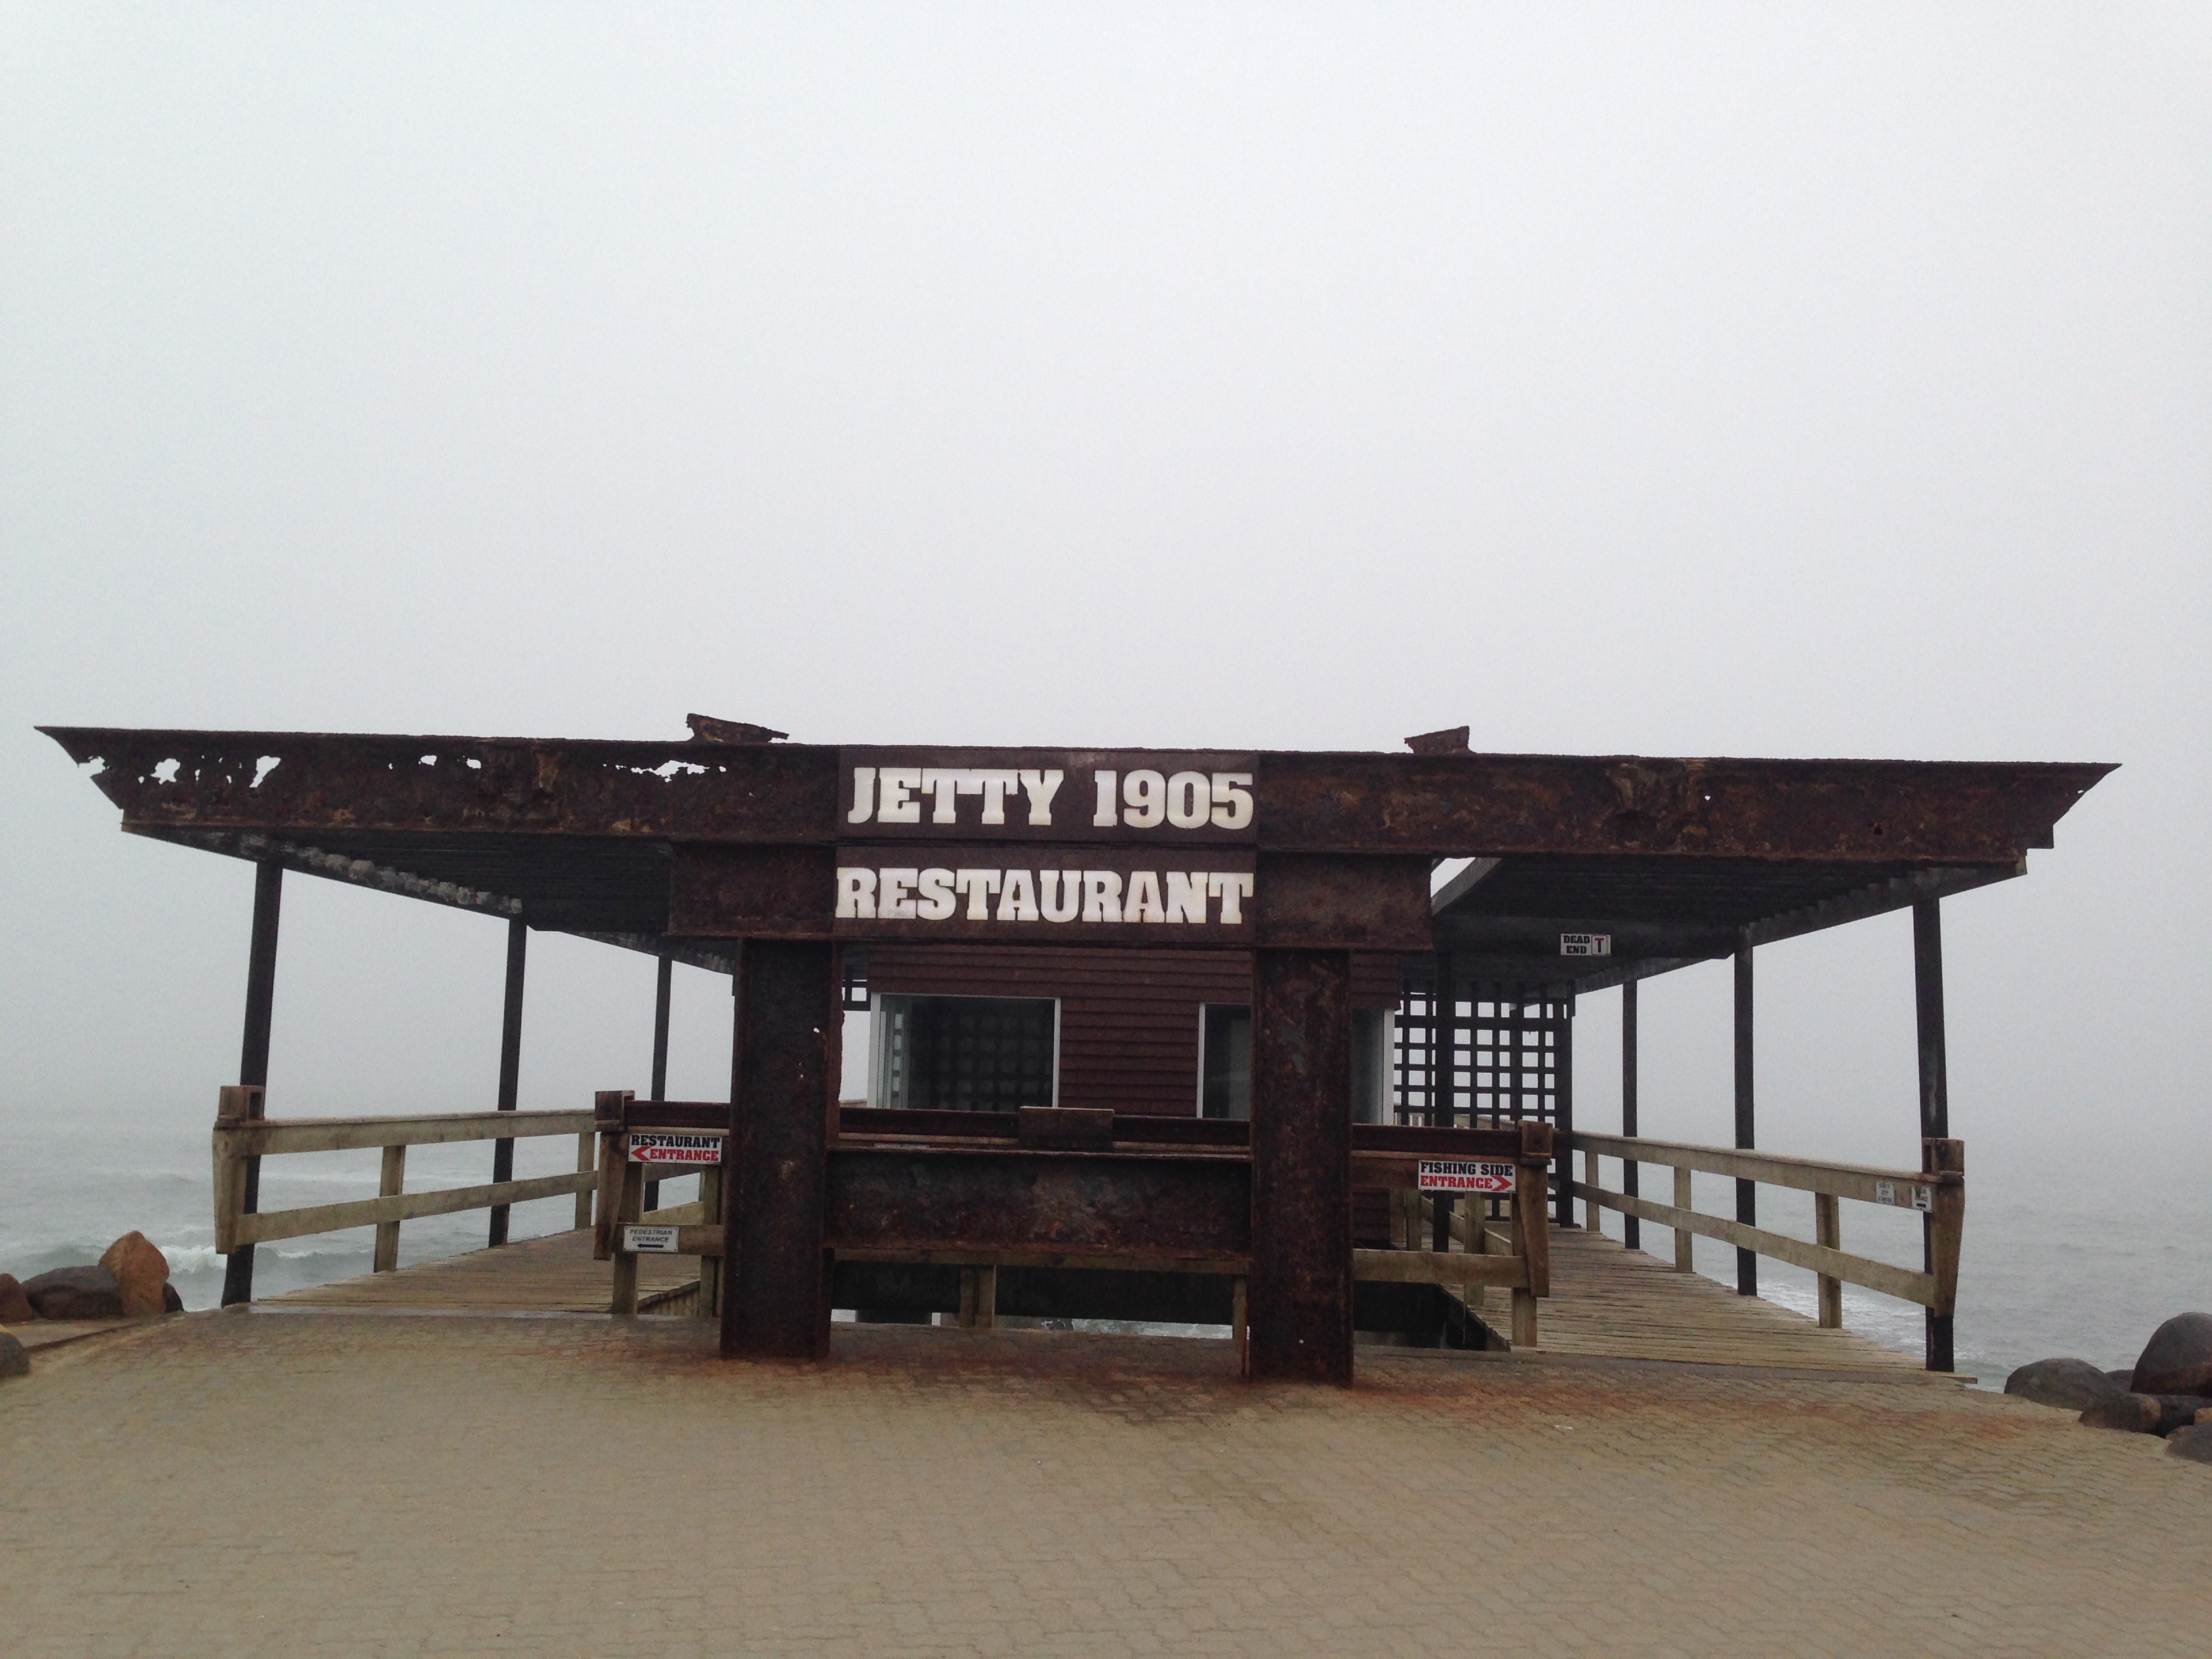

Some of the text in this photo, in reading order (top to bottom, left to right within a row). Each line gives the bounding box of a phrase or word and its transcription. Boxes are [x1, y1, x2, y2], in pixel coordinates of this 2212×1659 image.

[847, 766, 1254, 830] JETTY 1905
[835, 867, 1254, 924] RESTAURANT
[1563, 935, 1590, 943] DEAD
[1566, 945, 1586, 954] END
[631, 1134, 720, 1148] RESTAURANT
[650, 1148, 719, 1162] ENTRANCE
[1420, 1162, 1513, 1176] FISHING SIDE
[1420, 1175, 1493, 1189] ENTRANCE
